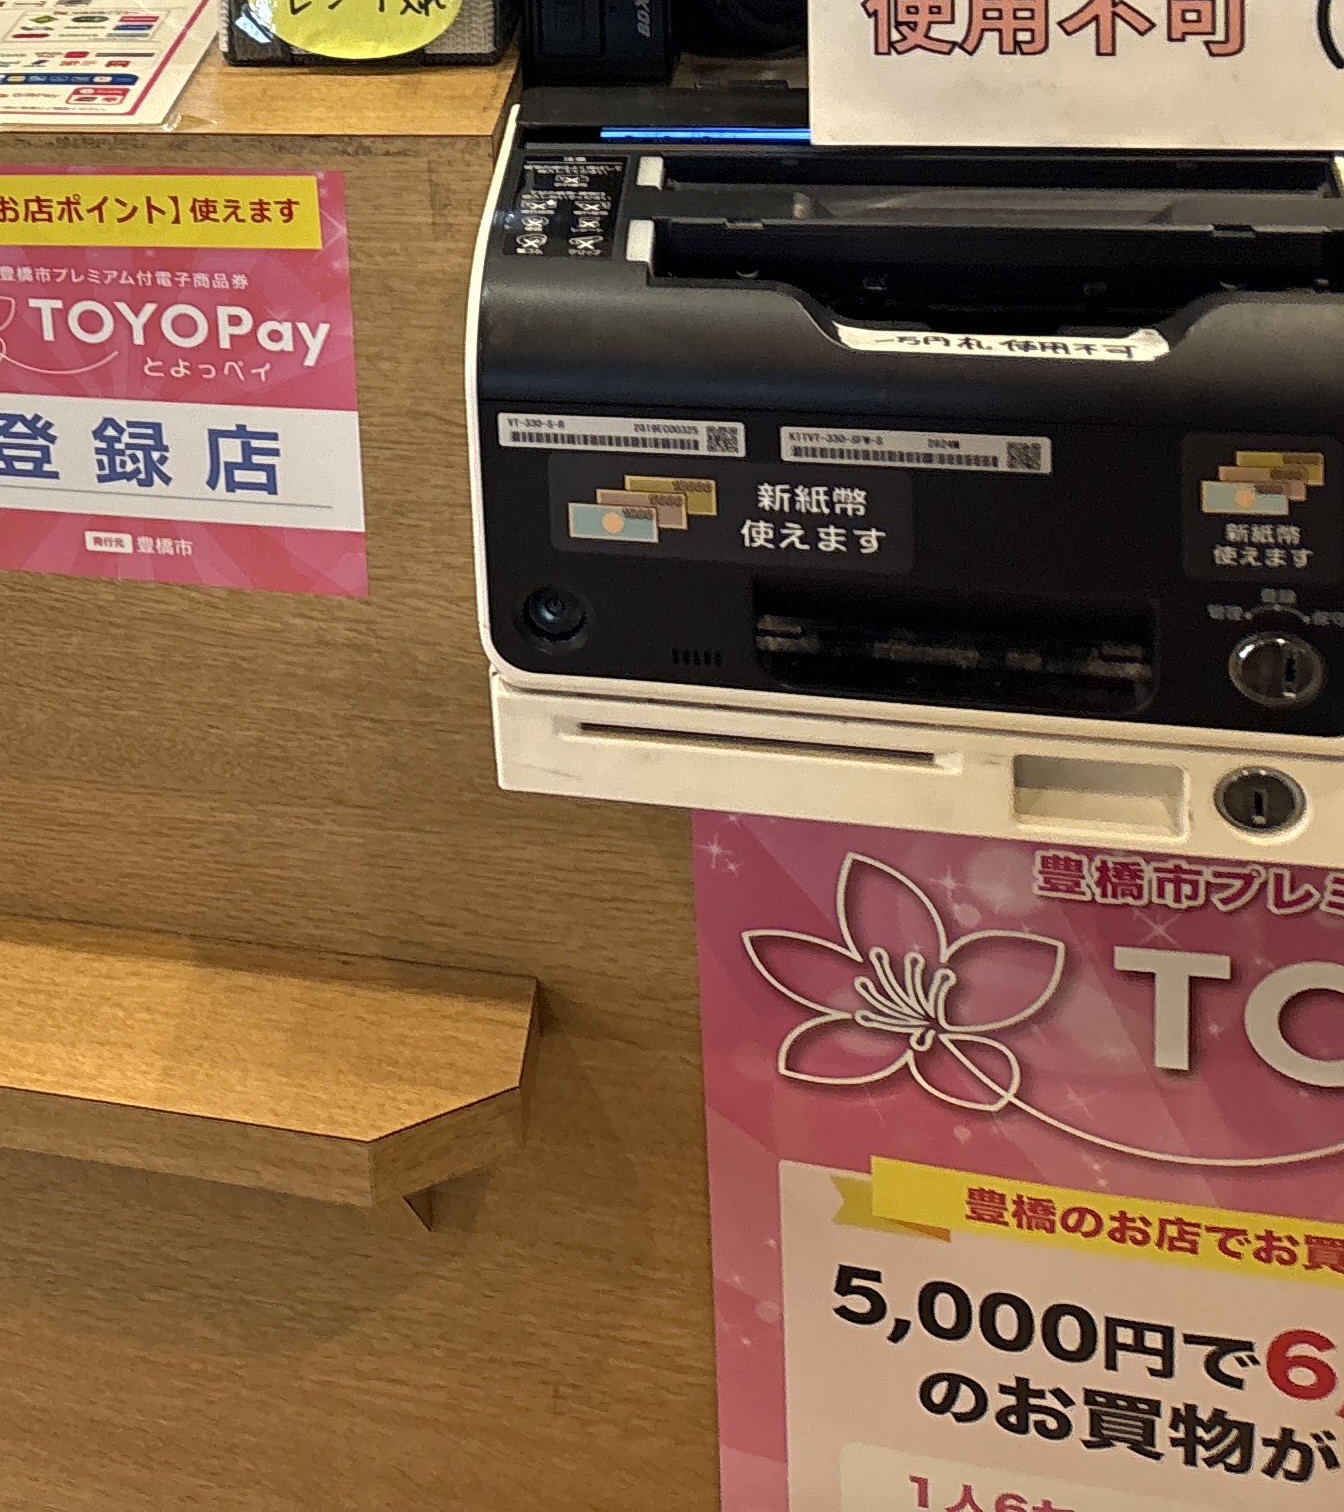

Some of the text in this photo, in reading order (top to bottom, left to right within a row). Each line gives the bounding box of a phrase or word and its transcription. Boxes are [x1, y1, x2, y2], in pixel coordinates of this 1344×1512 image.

[28, 297, 331, 366] TOYOPay
[757, 481, 868, 518] 新紙幣
[137, 535, 193, 556] 豊橋市
[740, 518, 886, 555] 使えます
[1212, 544, 1315, 569] 使えます
[1114, 946, 1344, 1088] TO
[964, 1185, 1344, 1274] 豊橋のお店でお買
[918, 1368, 1343, 1486] のお買物が
